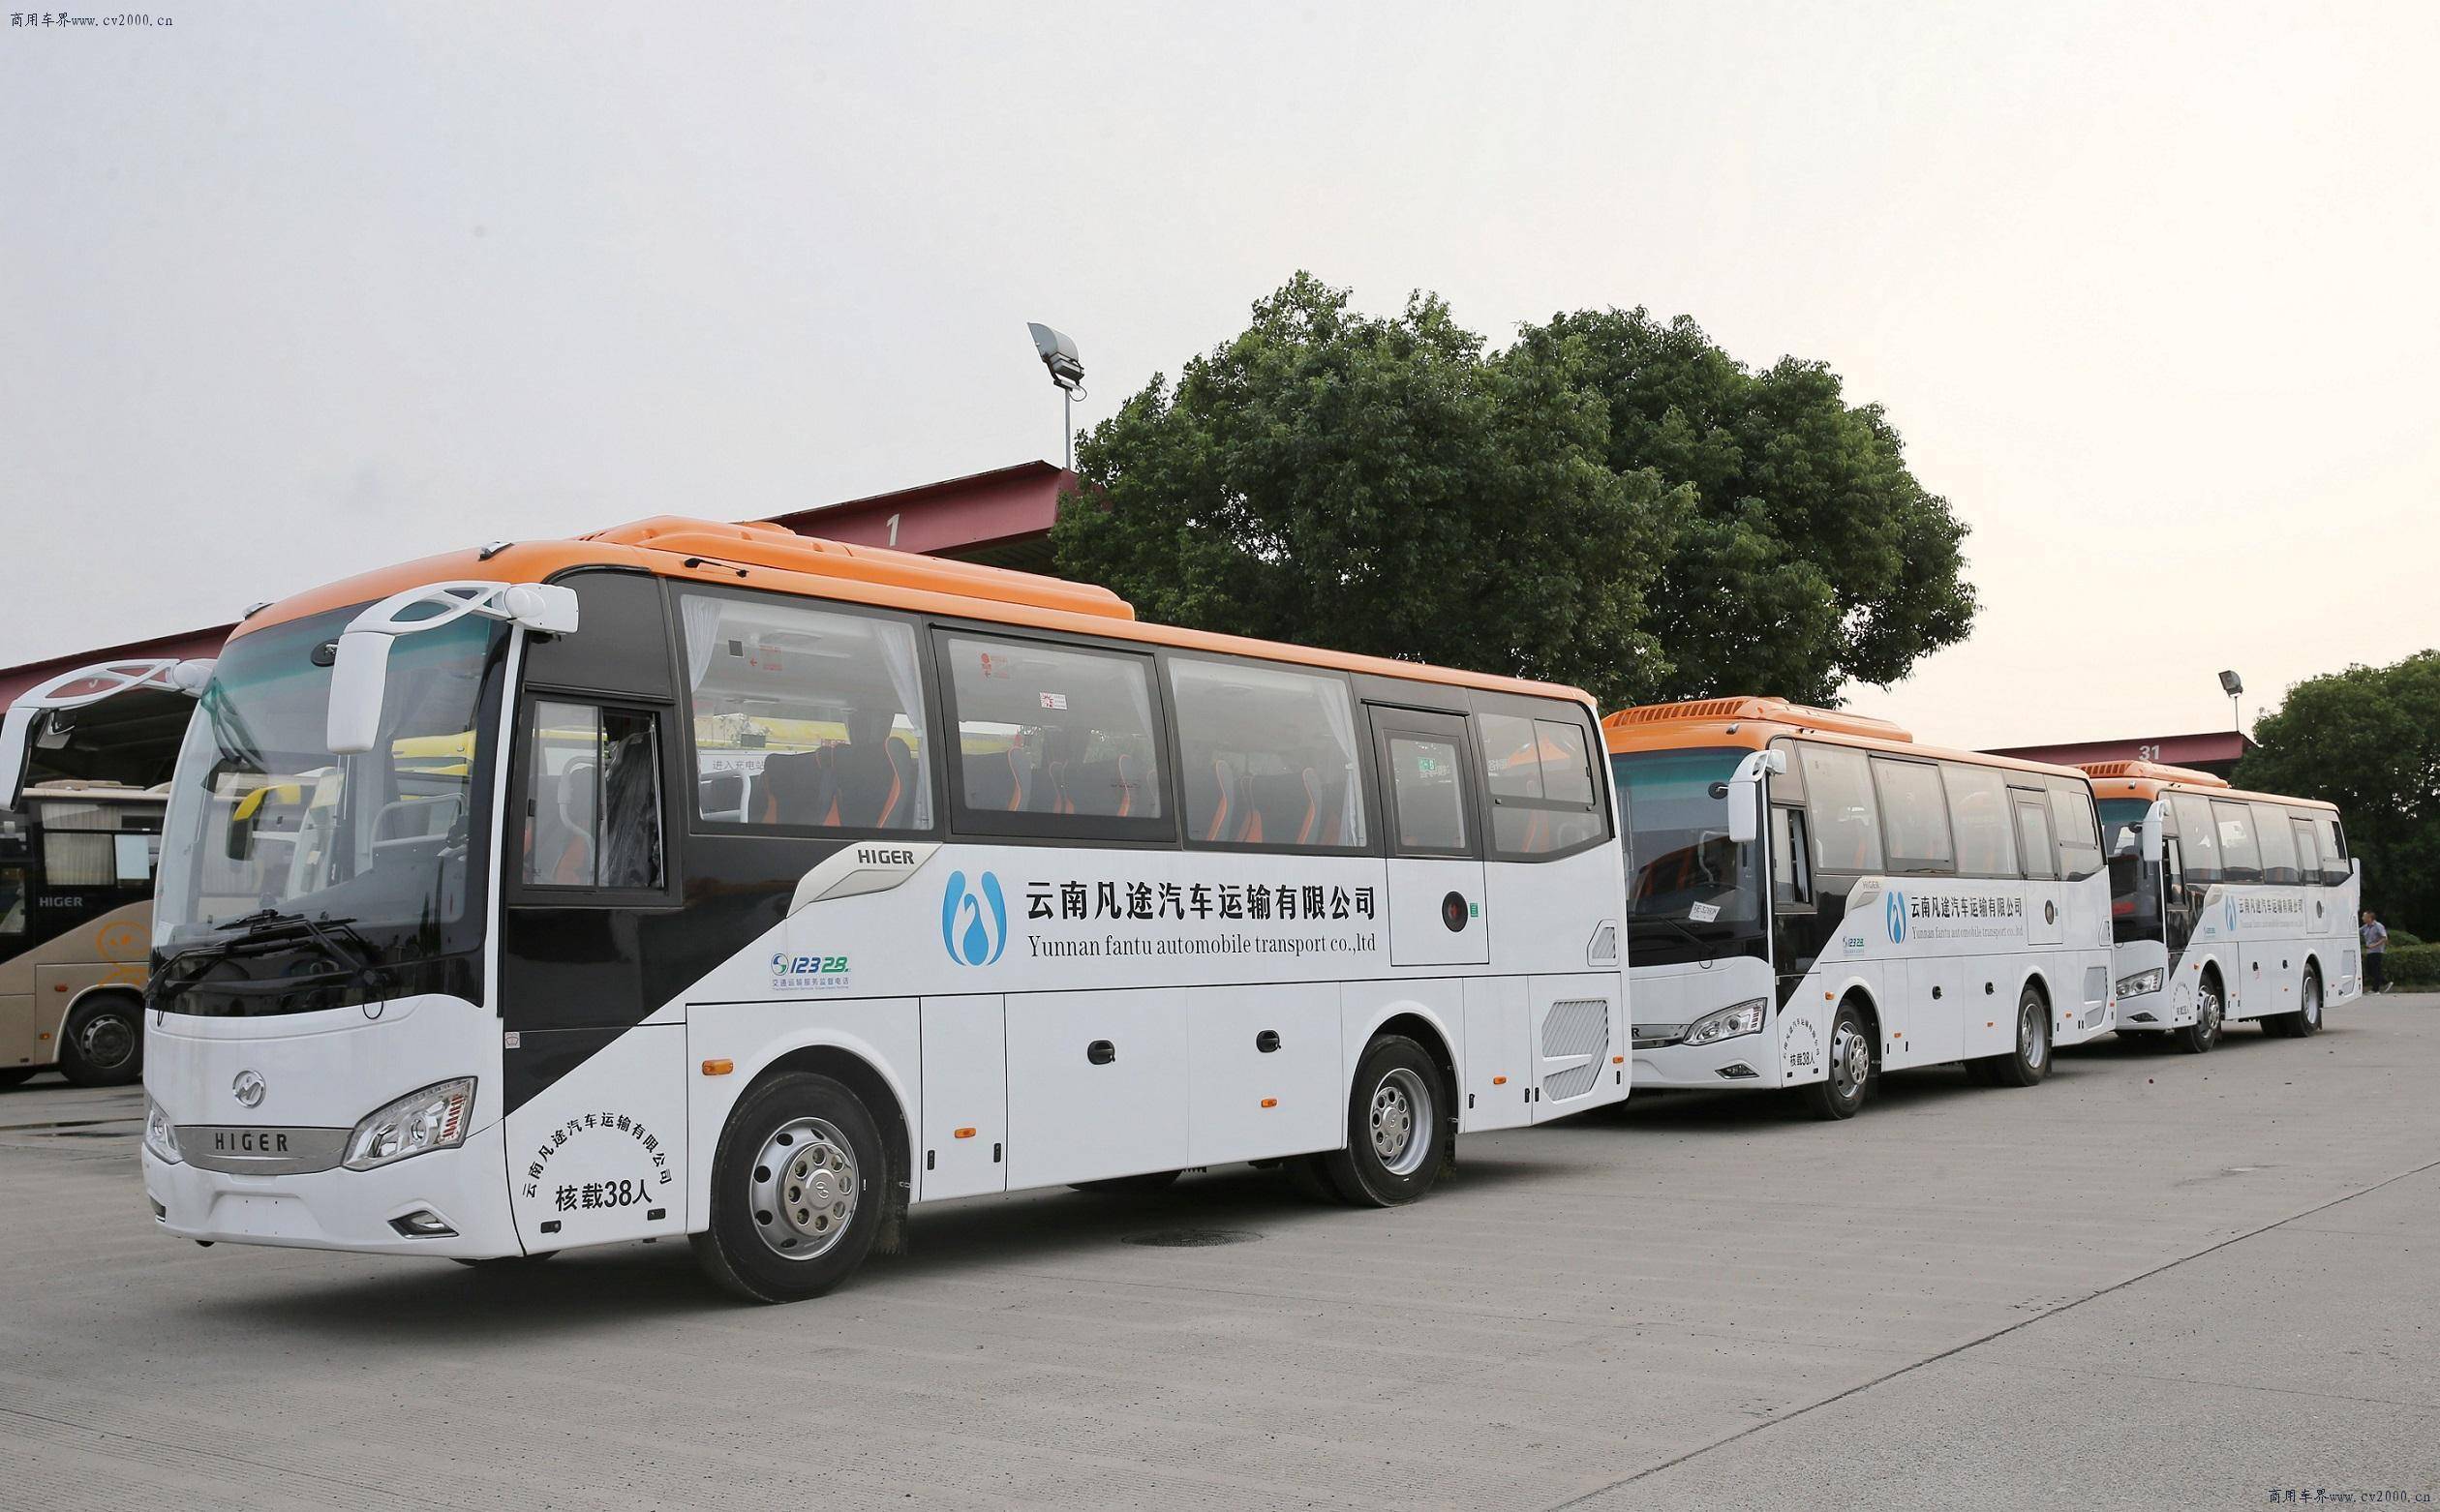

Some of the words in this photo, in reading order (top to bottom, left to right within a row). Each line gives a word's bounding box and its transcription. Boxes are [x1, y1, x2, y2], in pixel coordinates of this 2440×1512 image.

[886, 513, 900, 547] 1
[2139, 745, 2159, 760] 31
[858, 849, 914, 864] HIGER
[39, 896, 83, 907] HIGER
[1026, 881, 1375, 921] 云南凡途汽车运输有限公司
[1910, 896, 2022, 918] 云南凡途汽车运输有限公司
[1027, 935, 1101, 956] Yunnan
[1105, 934, 1152, 955] fantu
[1156, 933, 1251, 954] automobile
[1255, 935, 1327, 956] transport
[215, 1133, 289, 1152] HIGER
[523, 1112, 672, 1198] 云南凡途汽车运输有限公司
[555, 1179, 654, 1211] 核载38人
